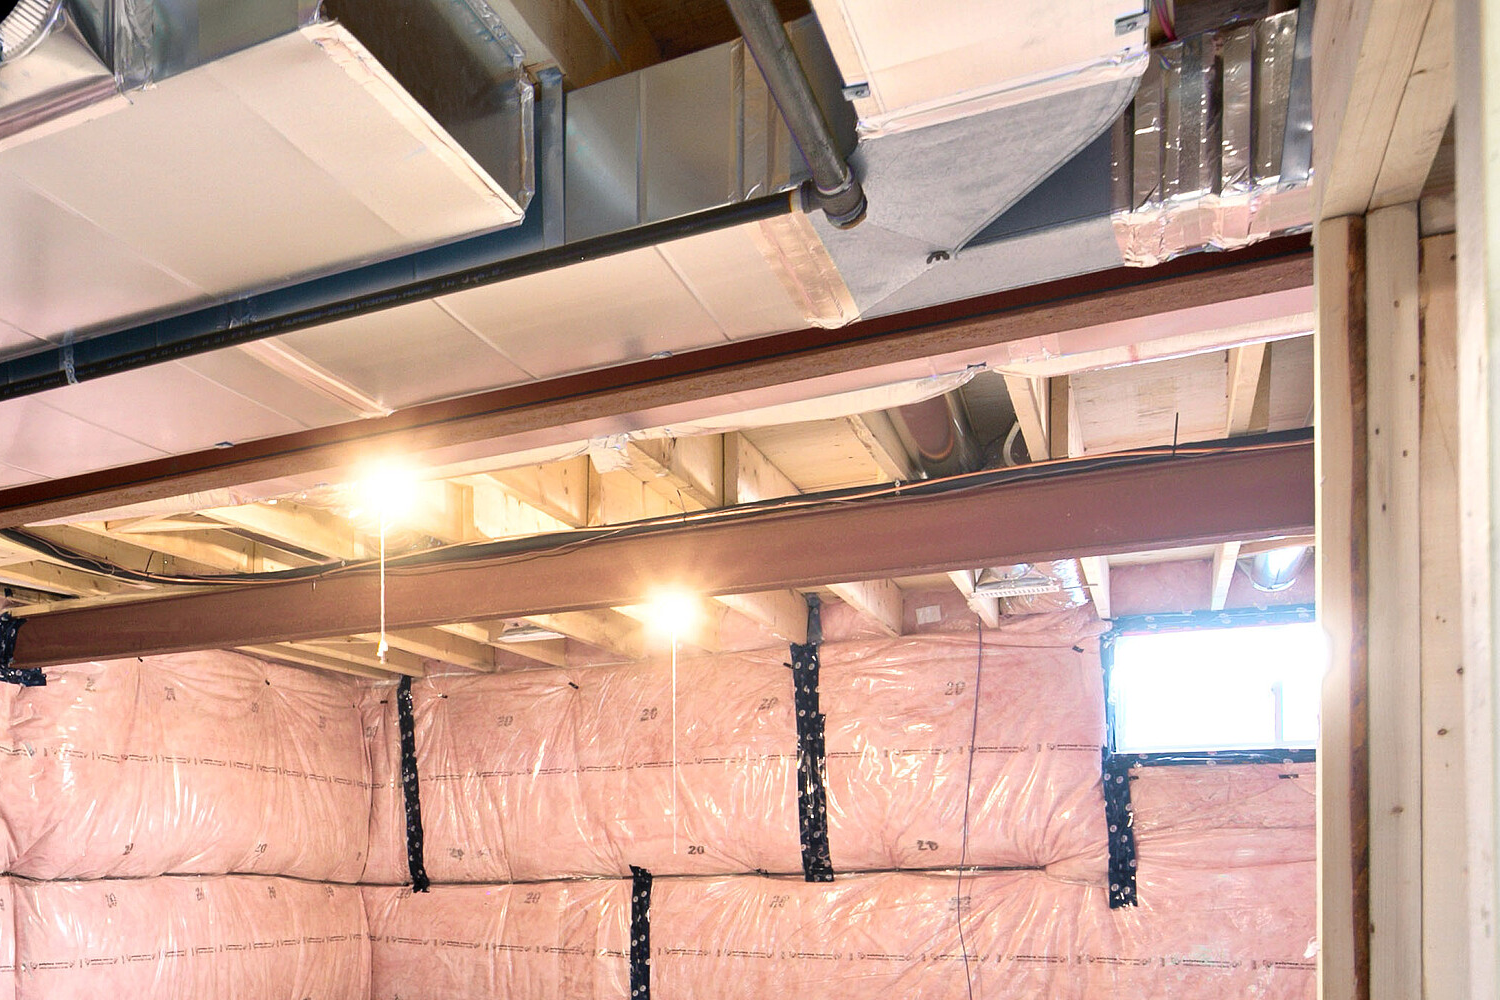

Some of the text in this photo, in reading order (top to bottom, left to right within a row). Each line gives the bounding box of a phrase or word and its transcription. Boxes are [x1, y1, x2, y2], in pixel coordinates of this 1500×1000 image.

[945, 681, 966, 697] 20
[640, 707, 659, 722] 20
[688, 845, 705, 855] 20
[917, 840, 939, 851] 20
